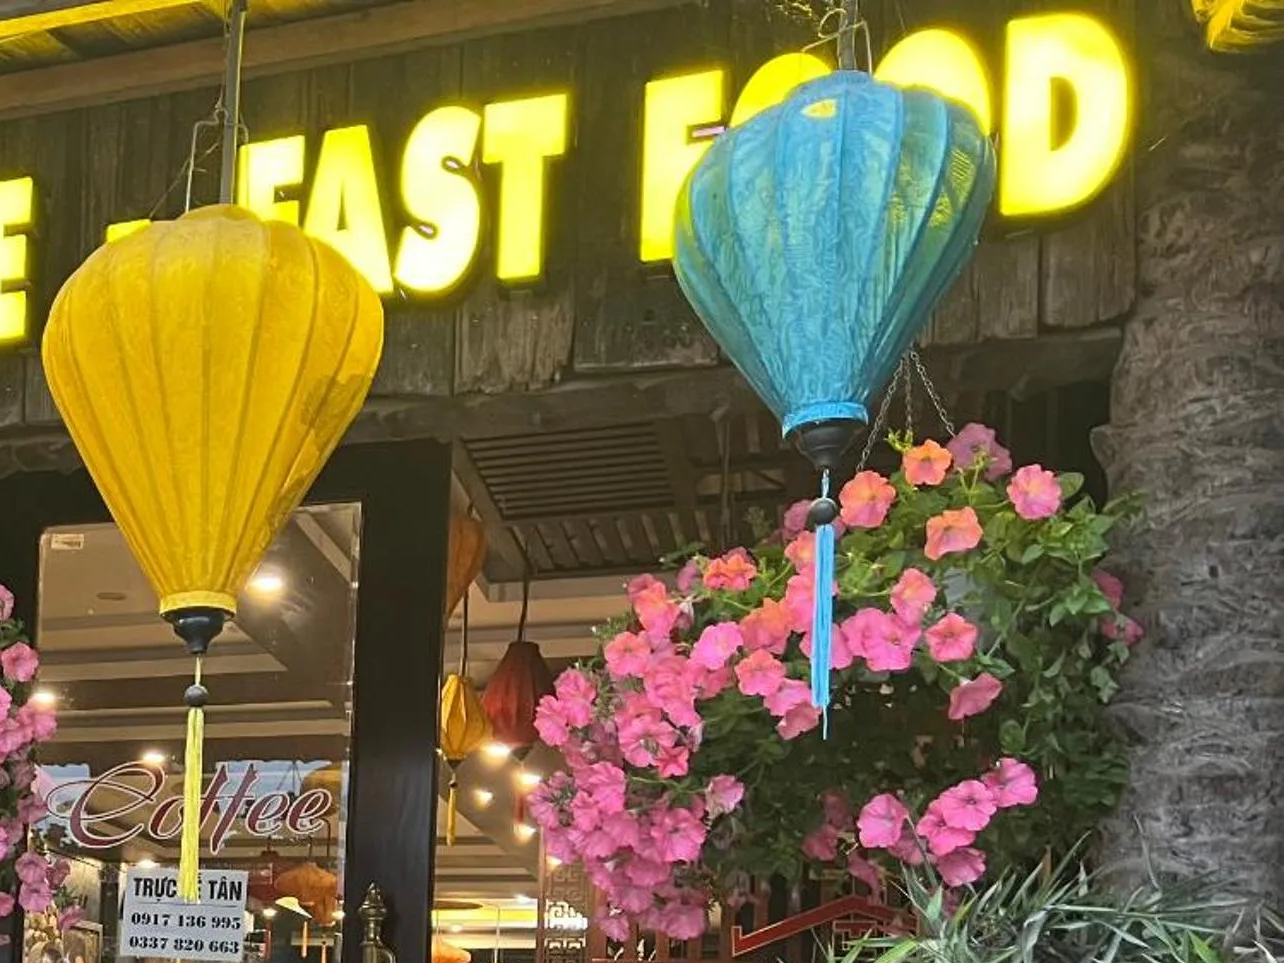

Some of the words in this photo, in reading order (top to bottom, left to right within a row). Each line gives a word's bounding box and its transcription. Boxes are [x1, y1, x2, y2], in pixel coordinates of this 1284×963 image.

[236, 93, 568, 293] FAST
[640, 13, 1129, 262] FD
[46, 760, 332, 854] Coffee
[209, 876, 242, 901] TÂN
[131, 912, 171, 927] 0917
[178, 915, 206, 929] 136
[211, 917, 241, 930] 995
[129, 936, 168, 950] 0337
[209, 941, 239, 955] 663
